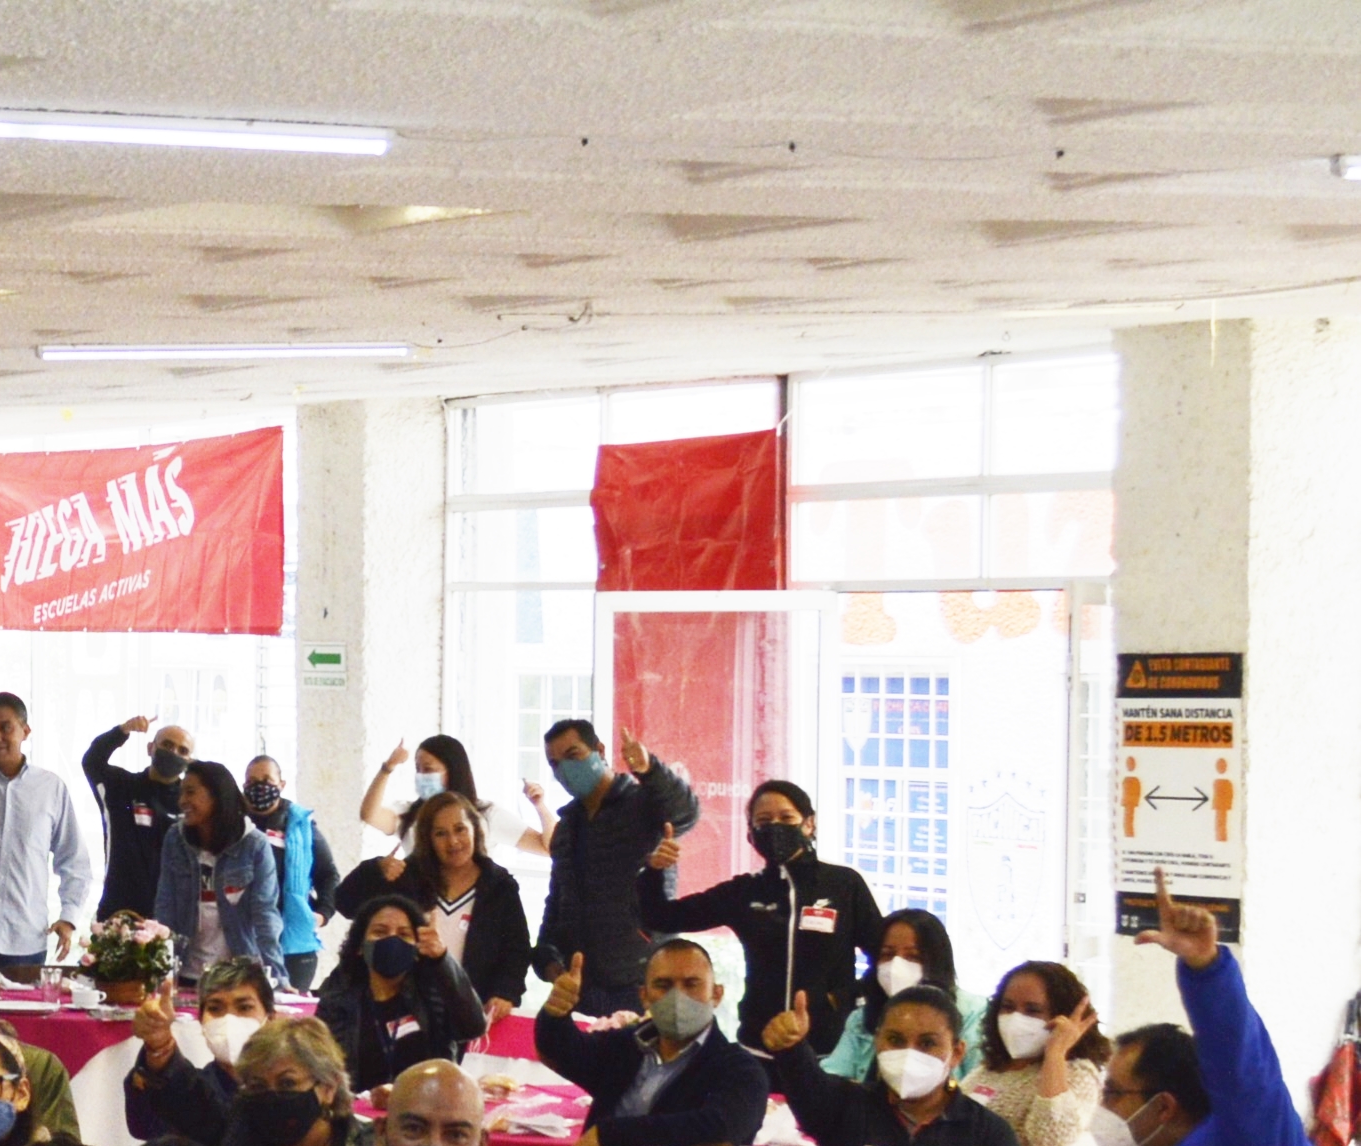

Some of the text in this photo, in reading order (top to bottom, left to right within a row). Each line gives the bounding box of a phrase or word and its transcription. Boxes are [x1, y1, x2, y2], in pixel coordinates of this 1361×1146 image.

[0, 446, 195, 593] JUEGA MÁS
[33, 569, 152, 624] ESCUELAS ACTIVAS
[1122, 705, 1233, 719] MANTÉN SANA DISTANCIA
[1124, 724, 1233, 743] DE 1.5 METROS
